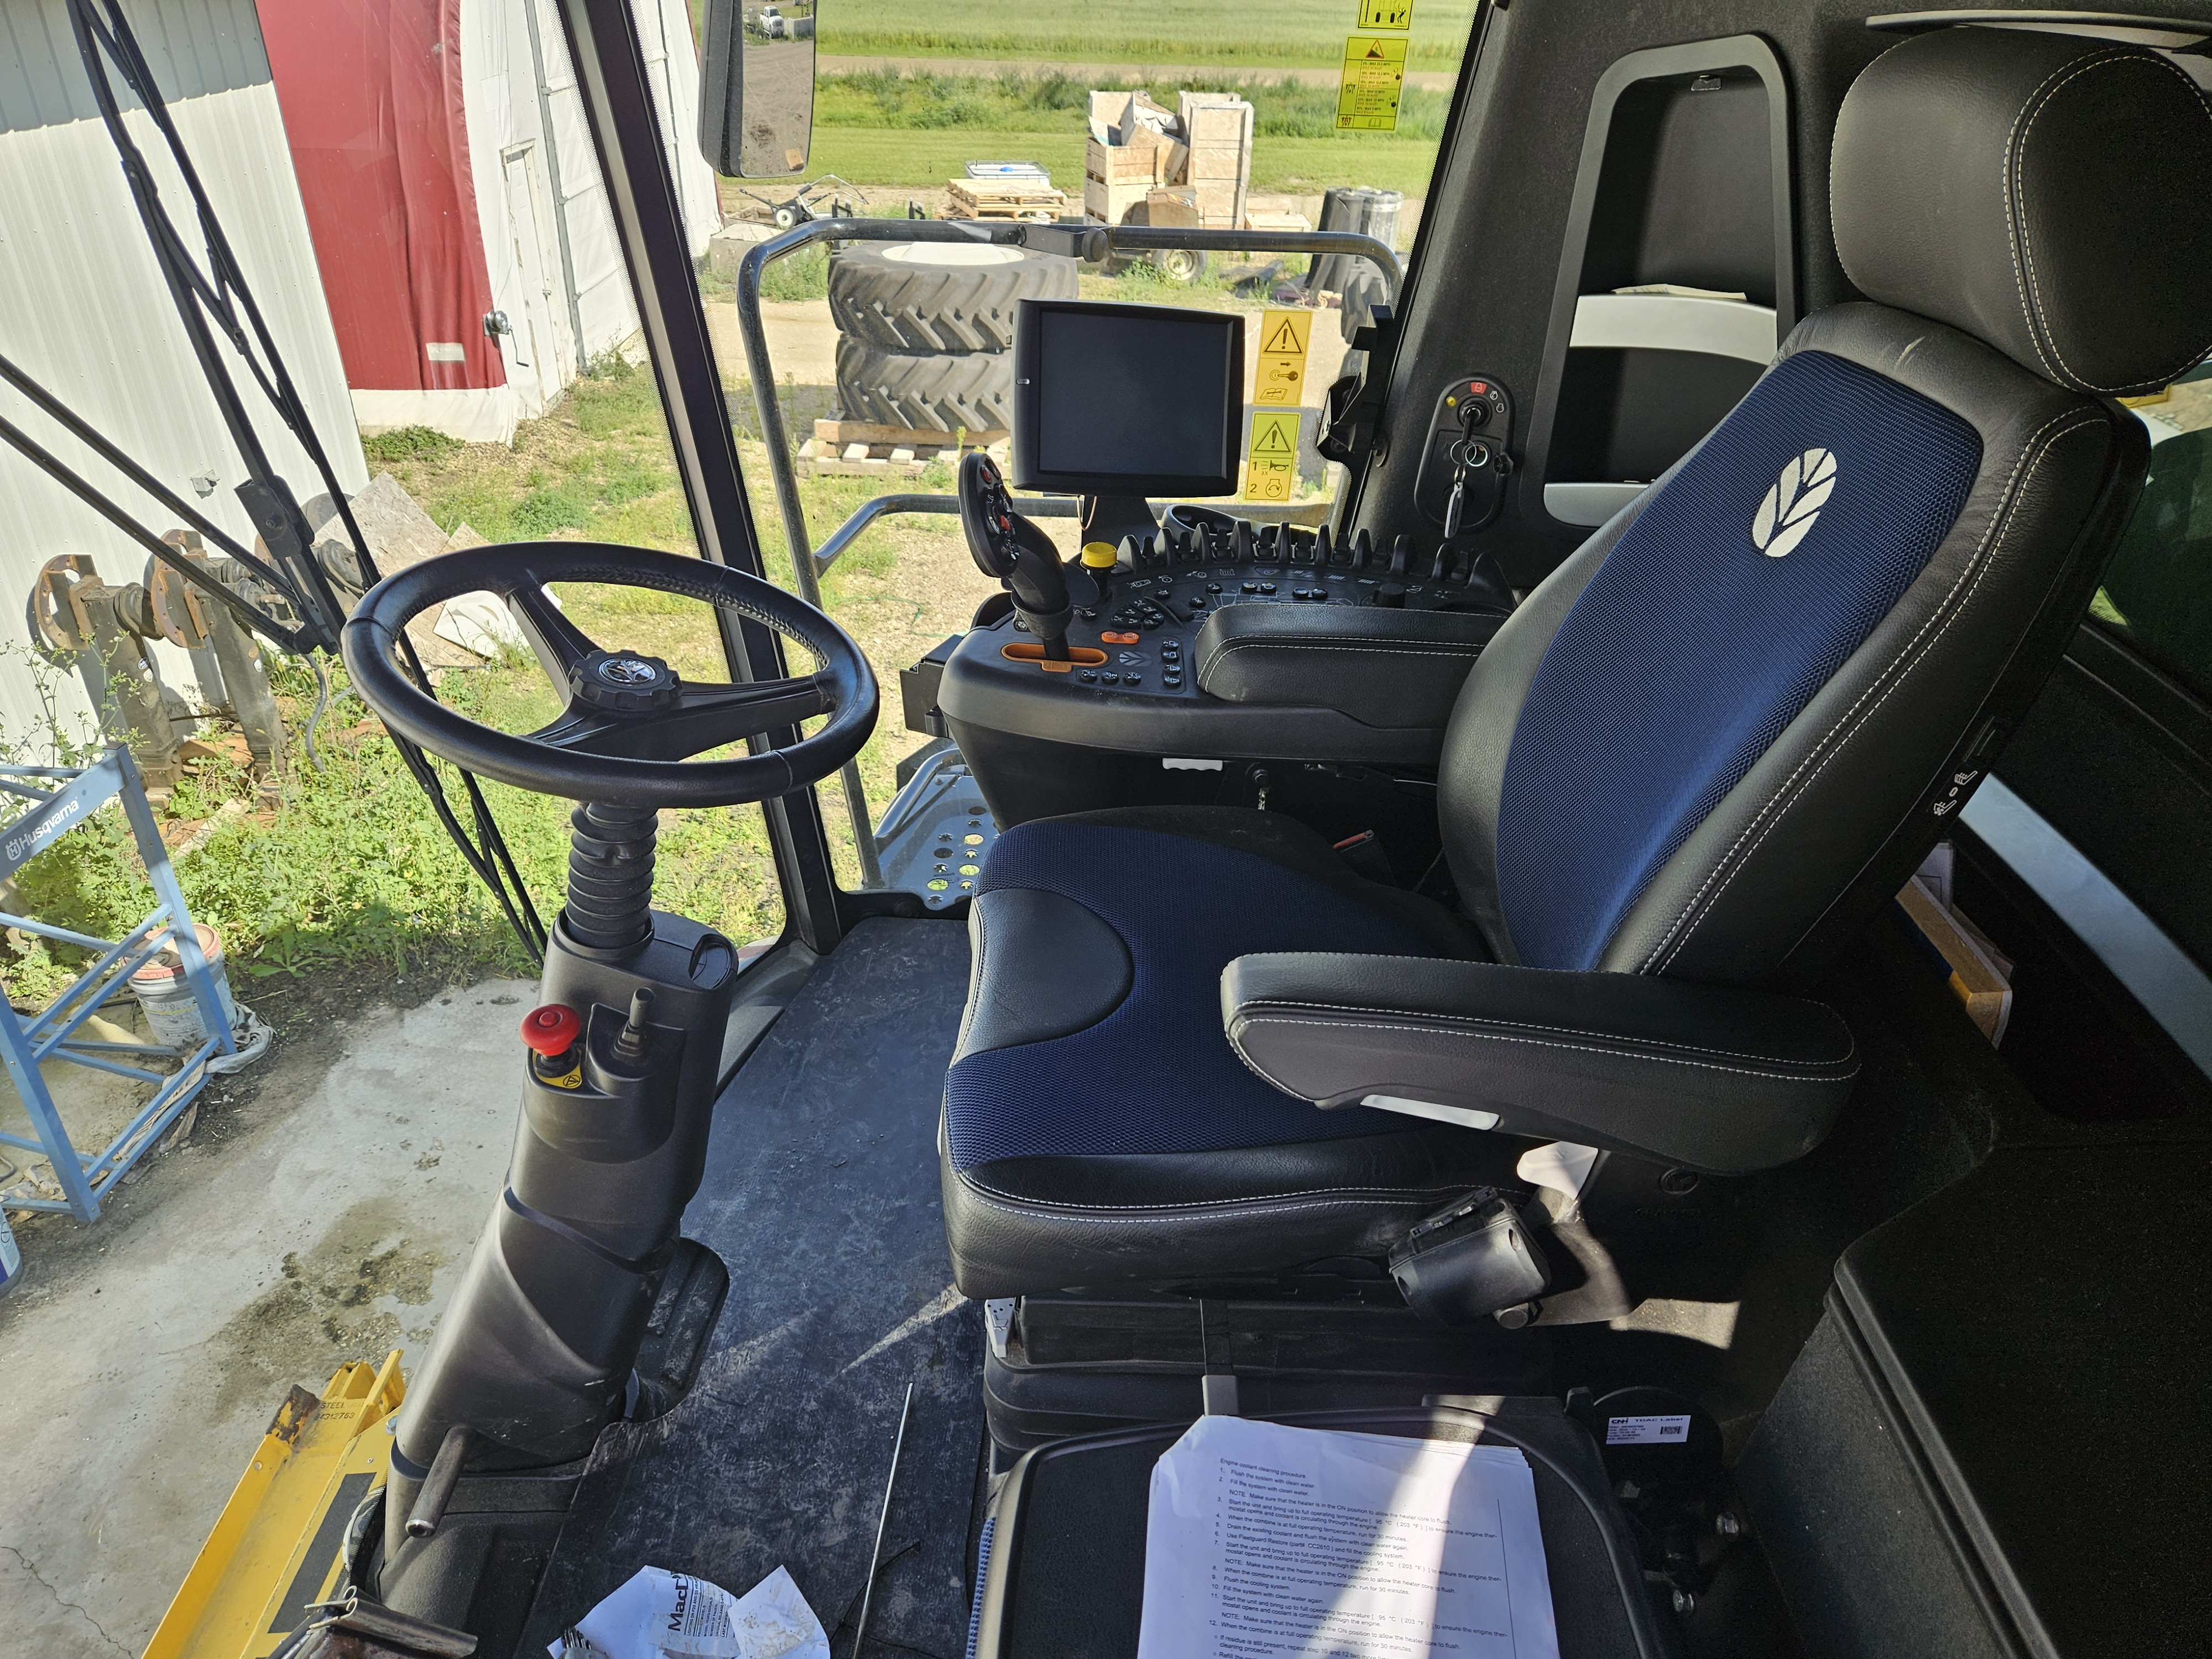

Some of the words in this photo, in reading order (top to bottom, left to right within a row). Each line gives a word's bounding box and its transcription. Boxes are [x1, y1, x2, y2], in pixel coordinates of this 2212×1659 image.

[1253, 461, 1257, 471] 1
[1250, 483, 1257, 493] 2
[18, 800, 79, 851] Husqvarna
[1258, 1467, 1279, 1475] cleaning
[1337, 1514, 1368, 1522] temperature
[1323, 1527, 1357, 1536] temperature,
[1238, 1534, 1266, 1542] Fleetguard
